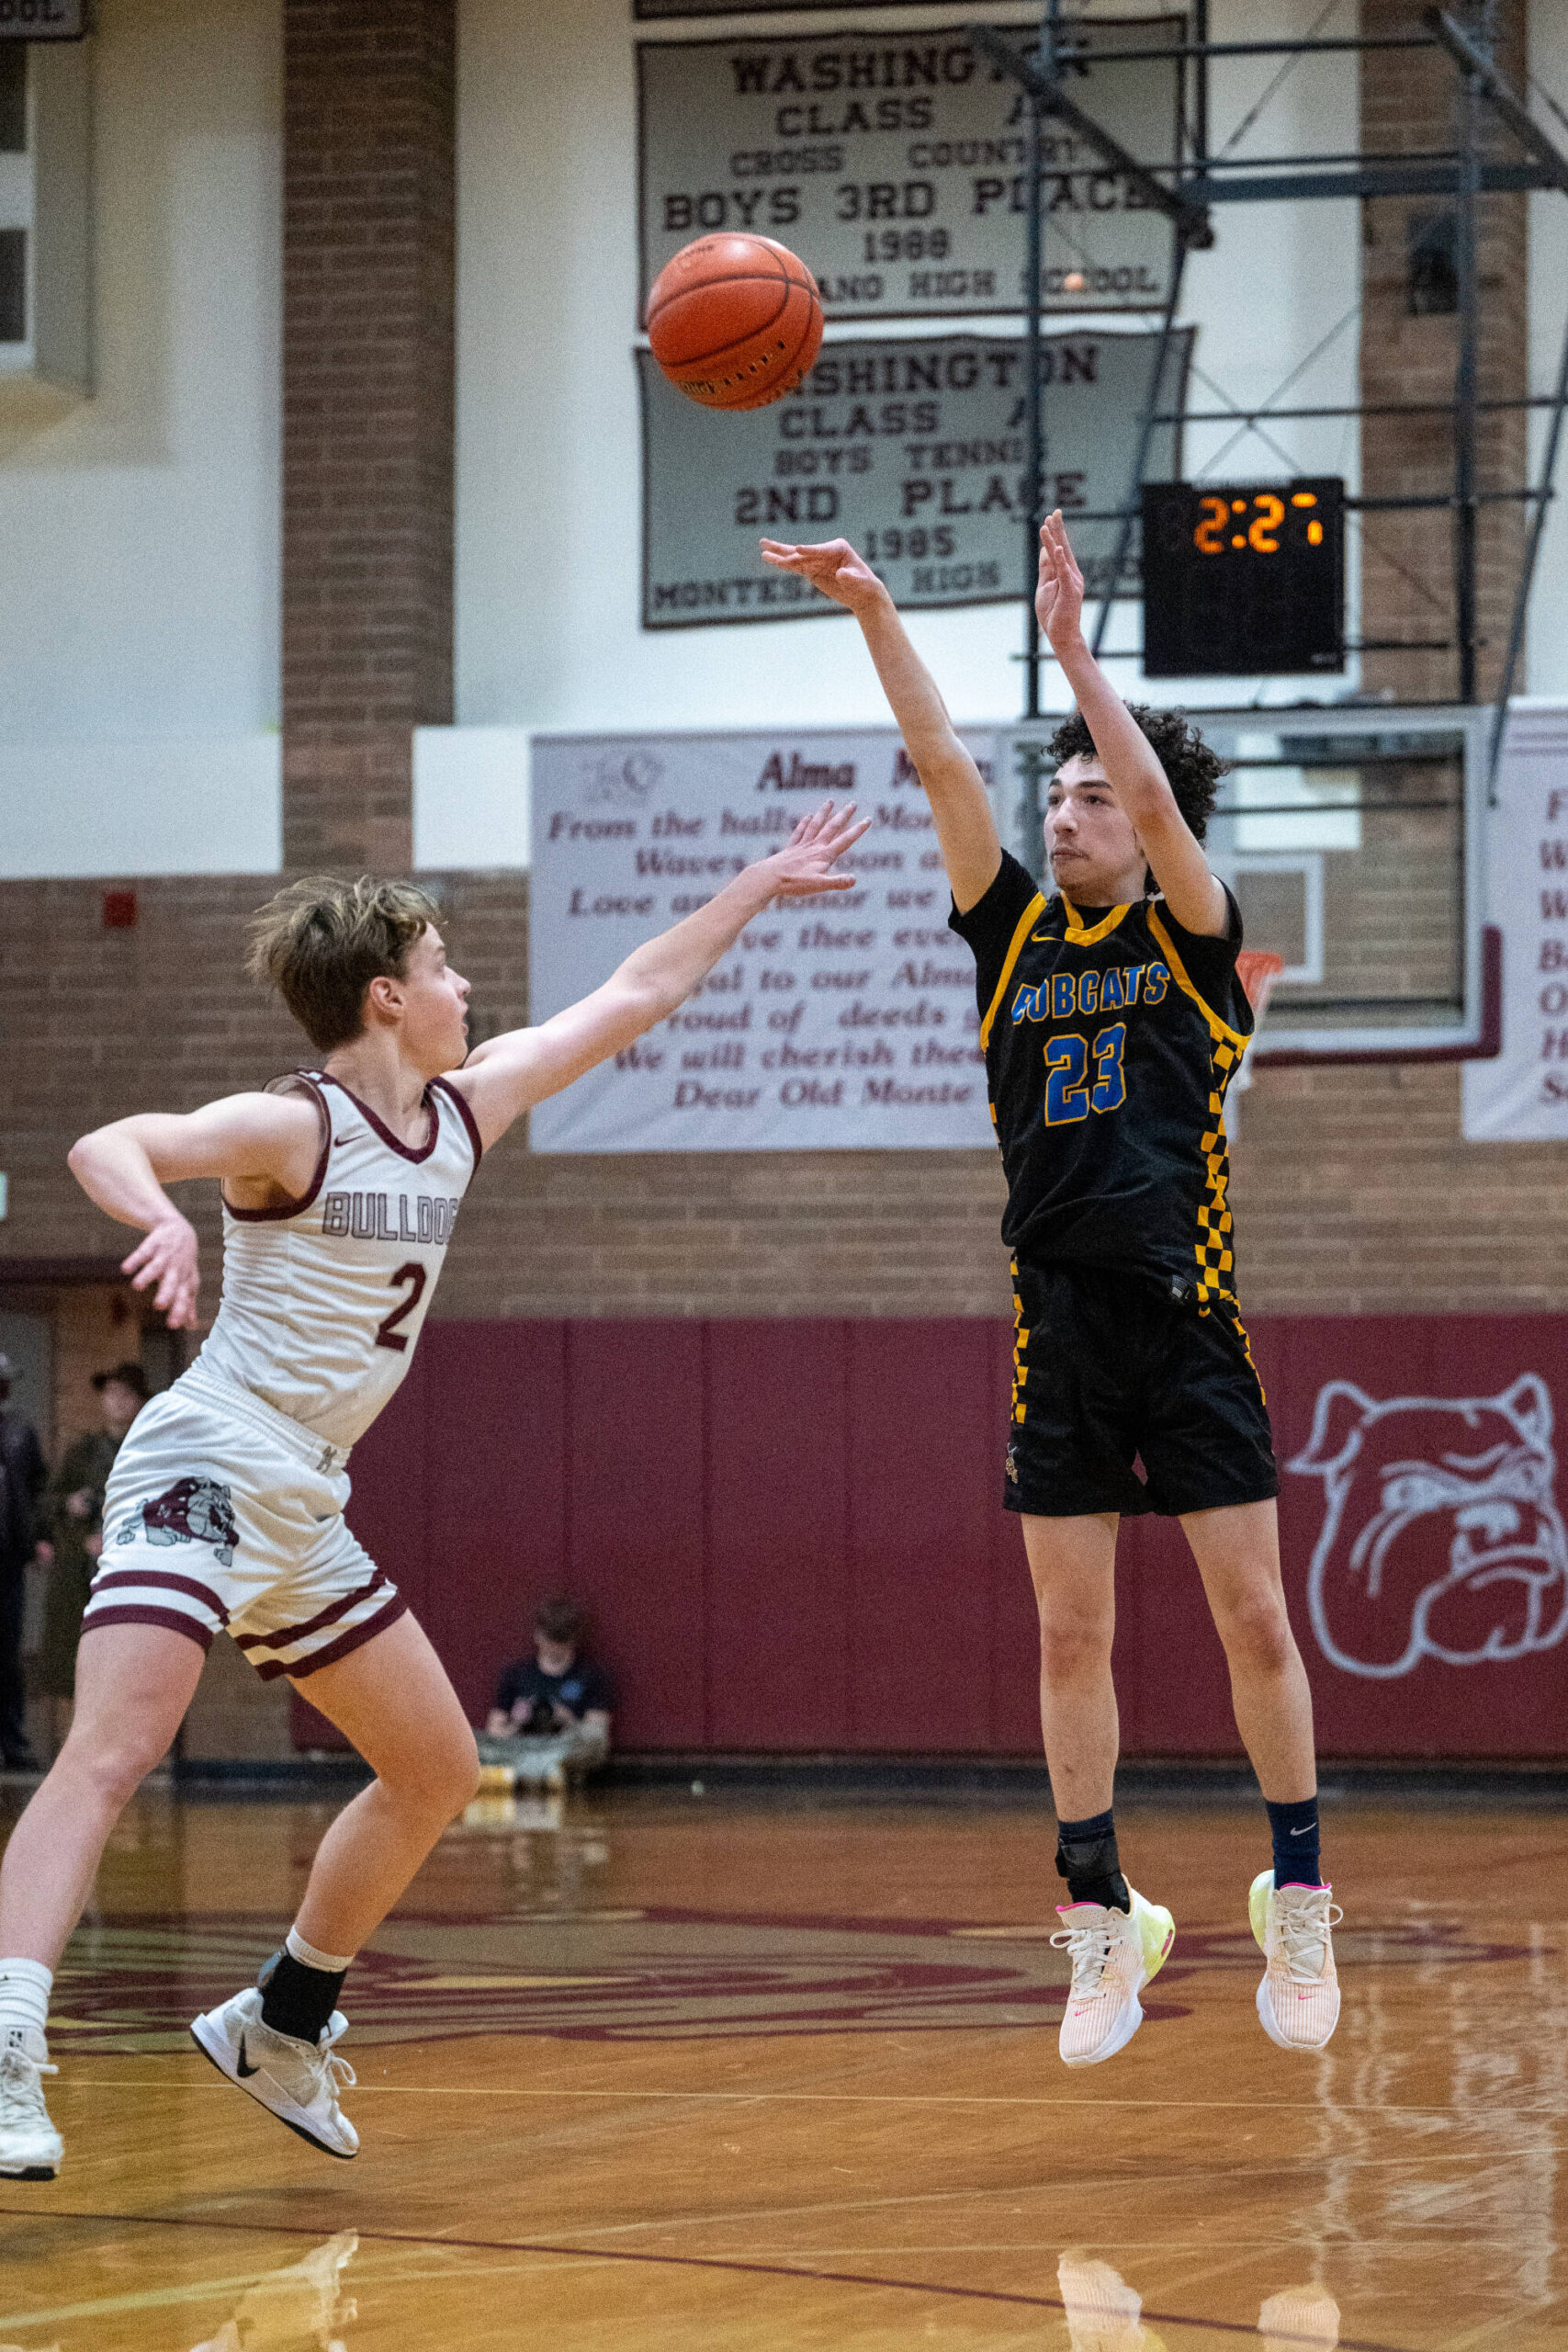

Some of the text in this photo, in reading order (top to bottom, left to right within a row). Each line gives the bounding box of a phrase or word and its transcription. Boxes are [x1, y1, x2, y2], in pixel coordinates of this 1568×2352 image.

[732, 39, 1089, 94] WASHING
[775, 96, 933, 137] CLASS
[730, 144, 844, 177] CROSS
[664, 186, 800, 232] BOYS
[835, 181, 935, 223] 3RD
[793, 345, 1098, 398] SHINGTON
[781, 399, 941, 440] CLASS
[736, 485, 839, 526] 2ND
[1194, 492, 1324, 554] 2:27
[756, 751, 855, 791] Alma
[548, 809, 636, 841] From
[651, 809, 705, 837] the
[569, 888, 652, 917] Love
[795, 922, 874, 948] thee
[668, 1001, 751, 1030] roud
[674, 1080, 761, 1109] Dear
[781, 1077, 844, 1107] Old
[1043, 1022, 1127, 1127] 23
[375, 1262, 426, 1351] 2
